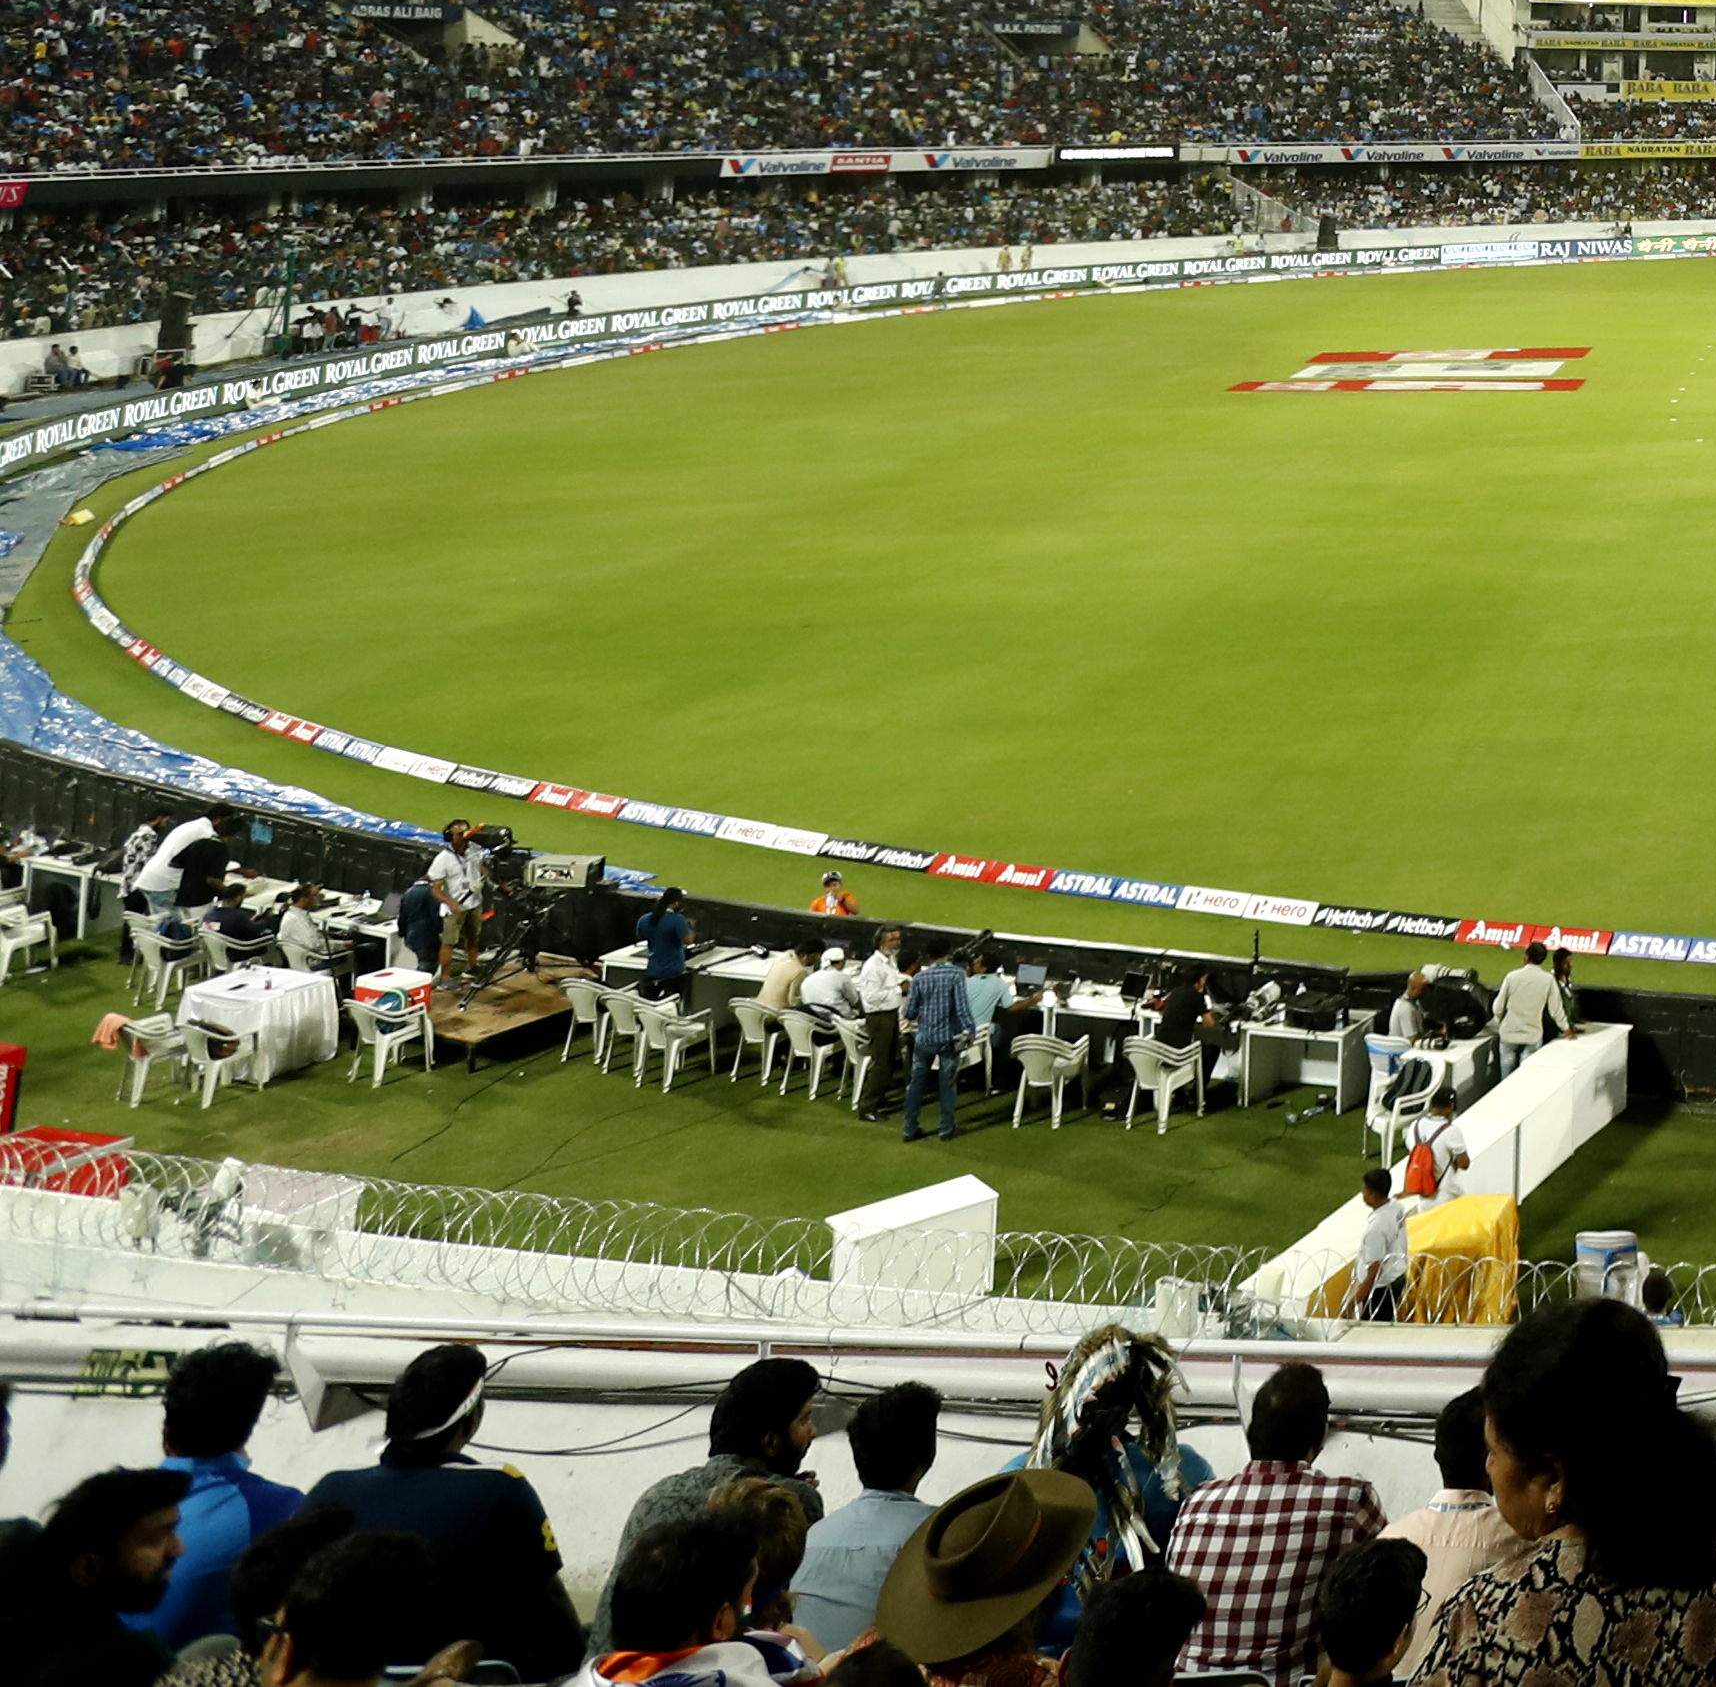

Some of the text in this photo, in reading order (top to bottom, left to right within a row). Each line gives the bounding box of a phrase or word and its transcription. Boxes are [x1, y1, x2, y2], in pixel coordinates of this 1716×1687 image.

[951, 156, 1017, 169] Valvoline
[1263, 151, 1322, 163] Valvoline
[1366, 150, 1424, 161] Valvoline
[1467, 148, 1524, 160] Valvoline
[758, 159, 826, 173] Valvoline
[1540, 242, 1570, 257] RAJ
[1577, 239, 1632, 256] NIWAS
[1271, 251, 1351, 269] ROYAL GREEN
[997, 268, 1087, 290] ROYAL GREEN
[713, 294, 801, 321] ROYAL GREEN
[325, 348, 416, 384] ROYAL GREEN
[36, 405, 120, 453] ROYAL GREEN
[669, 811, 721, 835] ASTRAL
[939, 854, 986, 877] Amul
[996, 863, 1045, 887] Amul
[1050, 872, 1112, 896] ASTRAL
[1114, 881, 1177, 905] ASTRAL
[1203, 895, 1239, 909] Hero
[1271, 902, 1307, 918] Hero
[1325, 907, 1375, 930] Hettich
[1398, 914, 1448, 935] Hettich
[1466, 920, 1523, 943] Amul
[1543, 927, 1599, 951] Amul
[1612, 935, 1687, 958] ASTRAL
